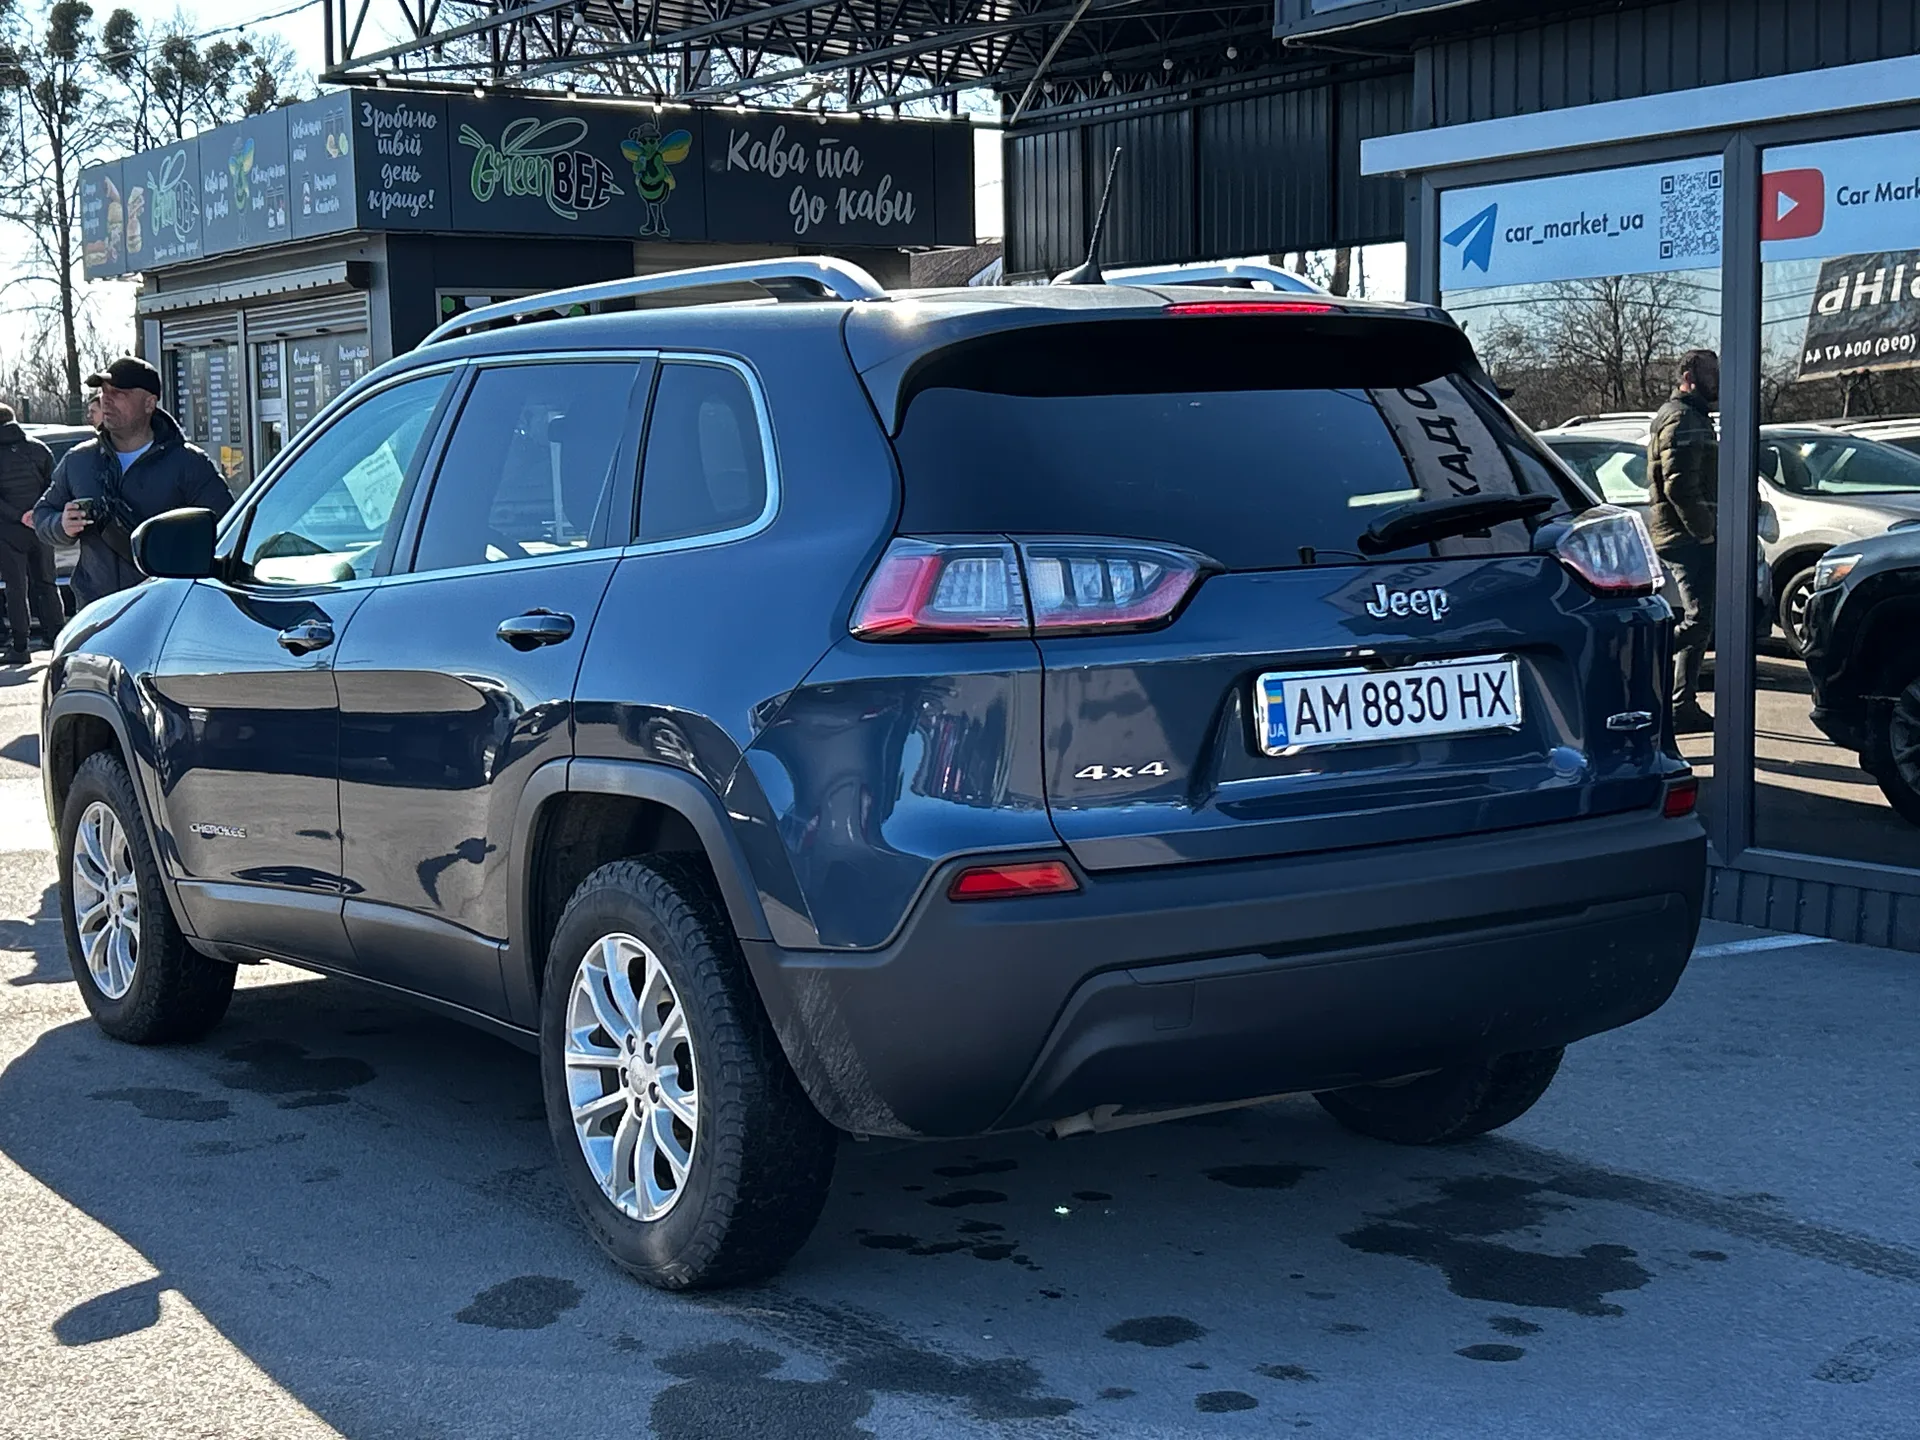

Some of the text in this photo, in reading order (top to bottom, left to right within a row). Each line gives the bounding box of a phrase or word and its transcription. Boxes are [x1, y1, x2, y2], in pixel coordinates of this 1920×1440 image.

[360, 101, 437, 136] Зробимо
[377, 132, 423, 157] твій
[726, 124, 864, 179] Кава та
[381, 163, 422, 188] день
[367, 189, 435, 219] краще!
[789, 174, 917, 235] до кави
[1837, 186, 1870, 206] Car
[1505, 211, 1643, 245] car_market_ua
[1367, 584, 1449, 621] Jeep
[1295, 670, 1512, 735] AM 8830 HX
[1268, 723, 1286, 738] UA
[1074, 761, 1170, 780] 4x4
